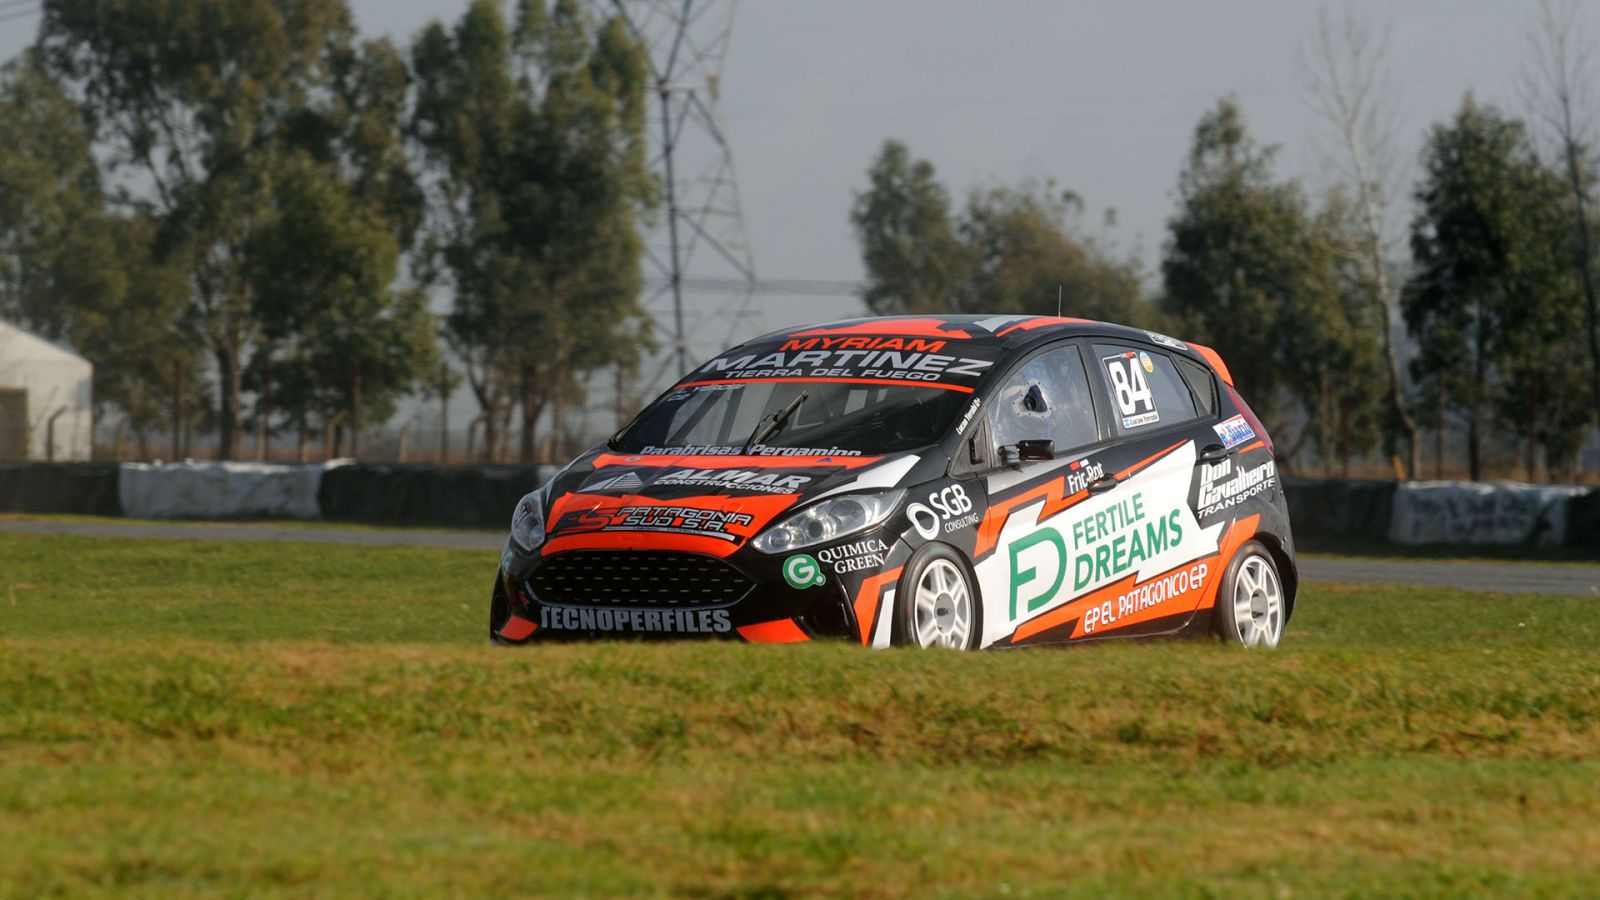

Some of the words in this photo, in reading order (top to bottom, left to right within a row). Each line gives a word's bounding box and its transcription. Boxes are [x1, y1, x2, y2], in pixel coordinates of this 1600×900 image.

[779, 337, 947, 353] MYRIAM
[700, 350, 994, 377] MARTINEZ
[725, 369, 803, 380] TIERRA
[810, 368, 854, 378] DEL
[862, 369, 941, 382] FUEGO
[1108, 357, 1153, 416] 84
[640, 444, 743, 457] Parabrisas
[656, 468, 812, 490] ALMAR
[1200, 459, 1231, 486] Don
[653, 478, 797, 495] CONSTRUCCIONES
[1198, 477, 1276, 520] TRANSPORTE
[929, 484, 972, 520] SGB
[617, 506, 752, 526] PATAGONIA
[623, 515, 673, 527] SUD
[944, 514, 979, 533] CONSULTING
[1072, 492, 1146, 550] FERTILE
[818, 539, 889, 564] QUIMICA
[1073, 508, 1183, 592] DREAMS
[833, 553, 886, 575] GREEN
[1118, 570, 1188, 620] PATAGONICO
[541, 607, 732, 632] TECNOPERFILES
